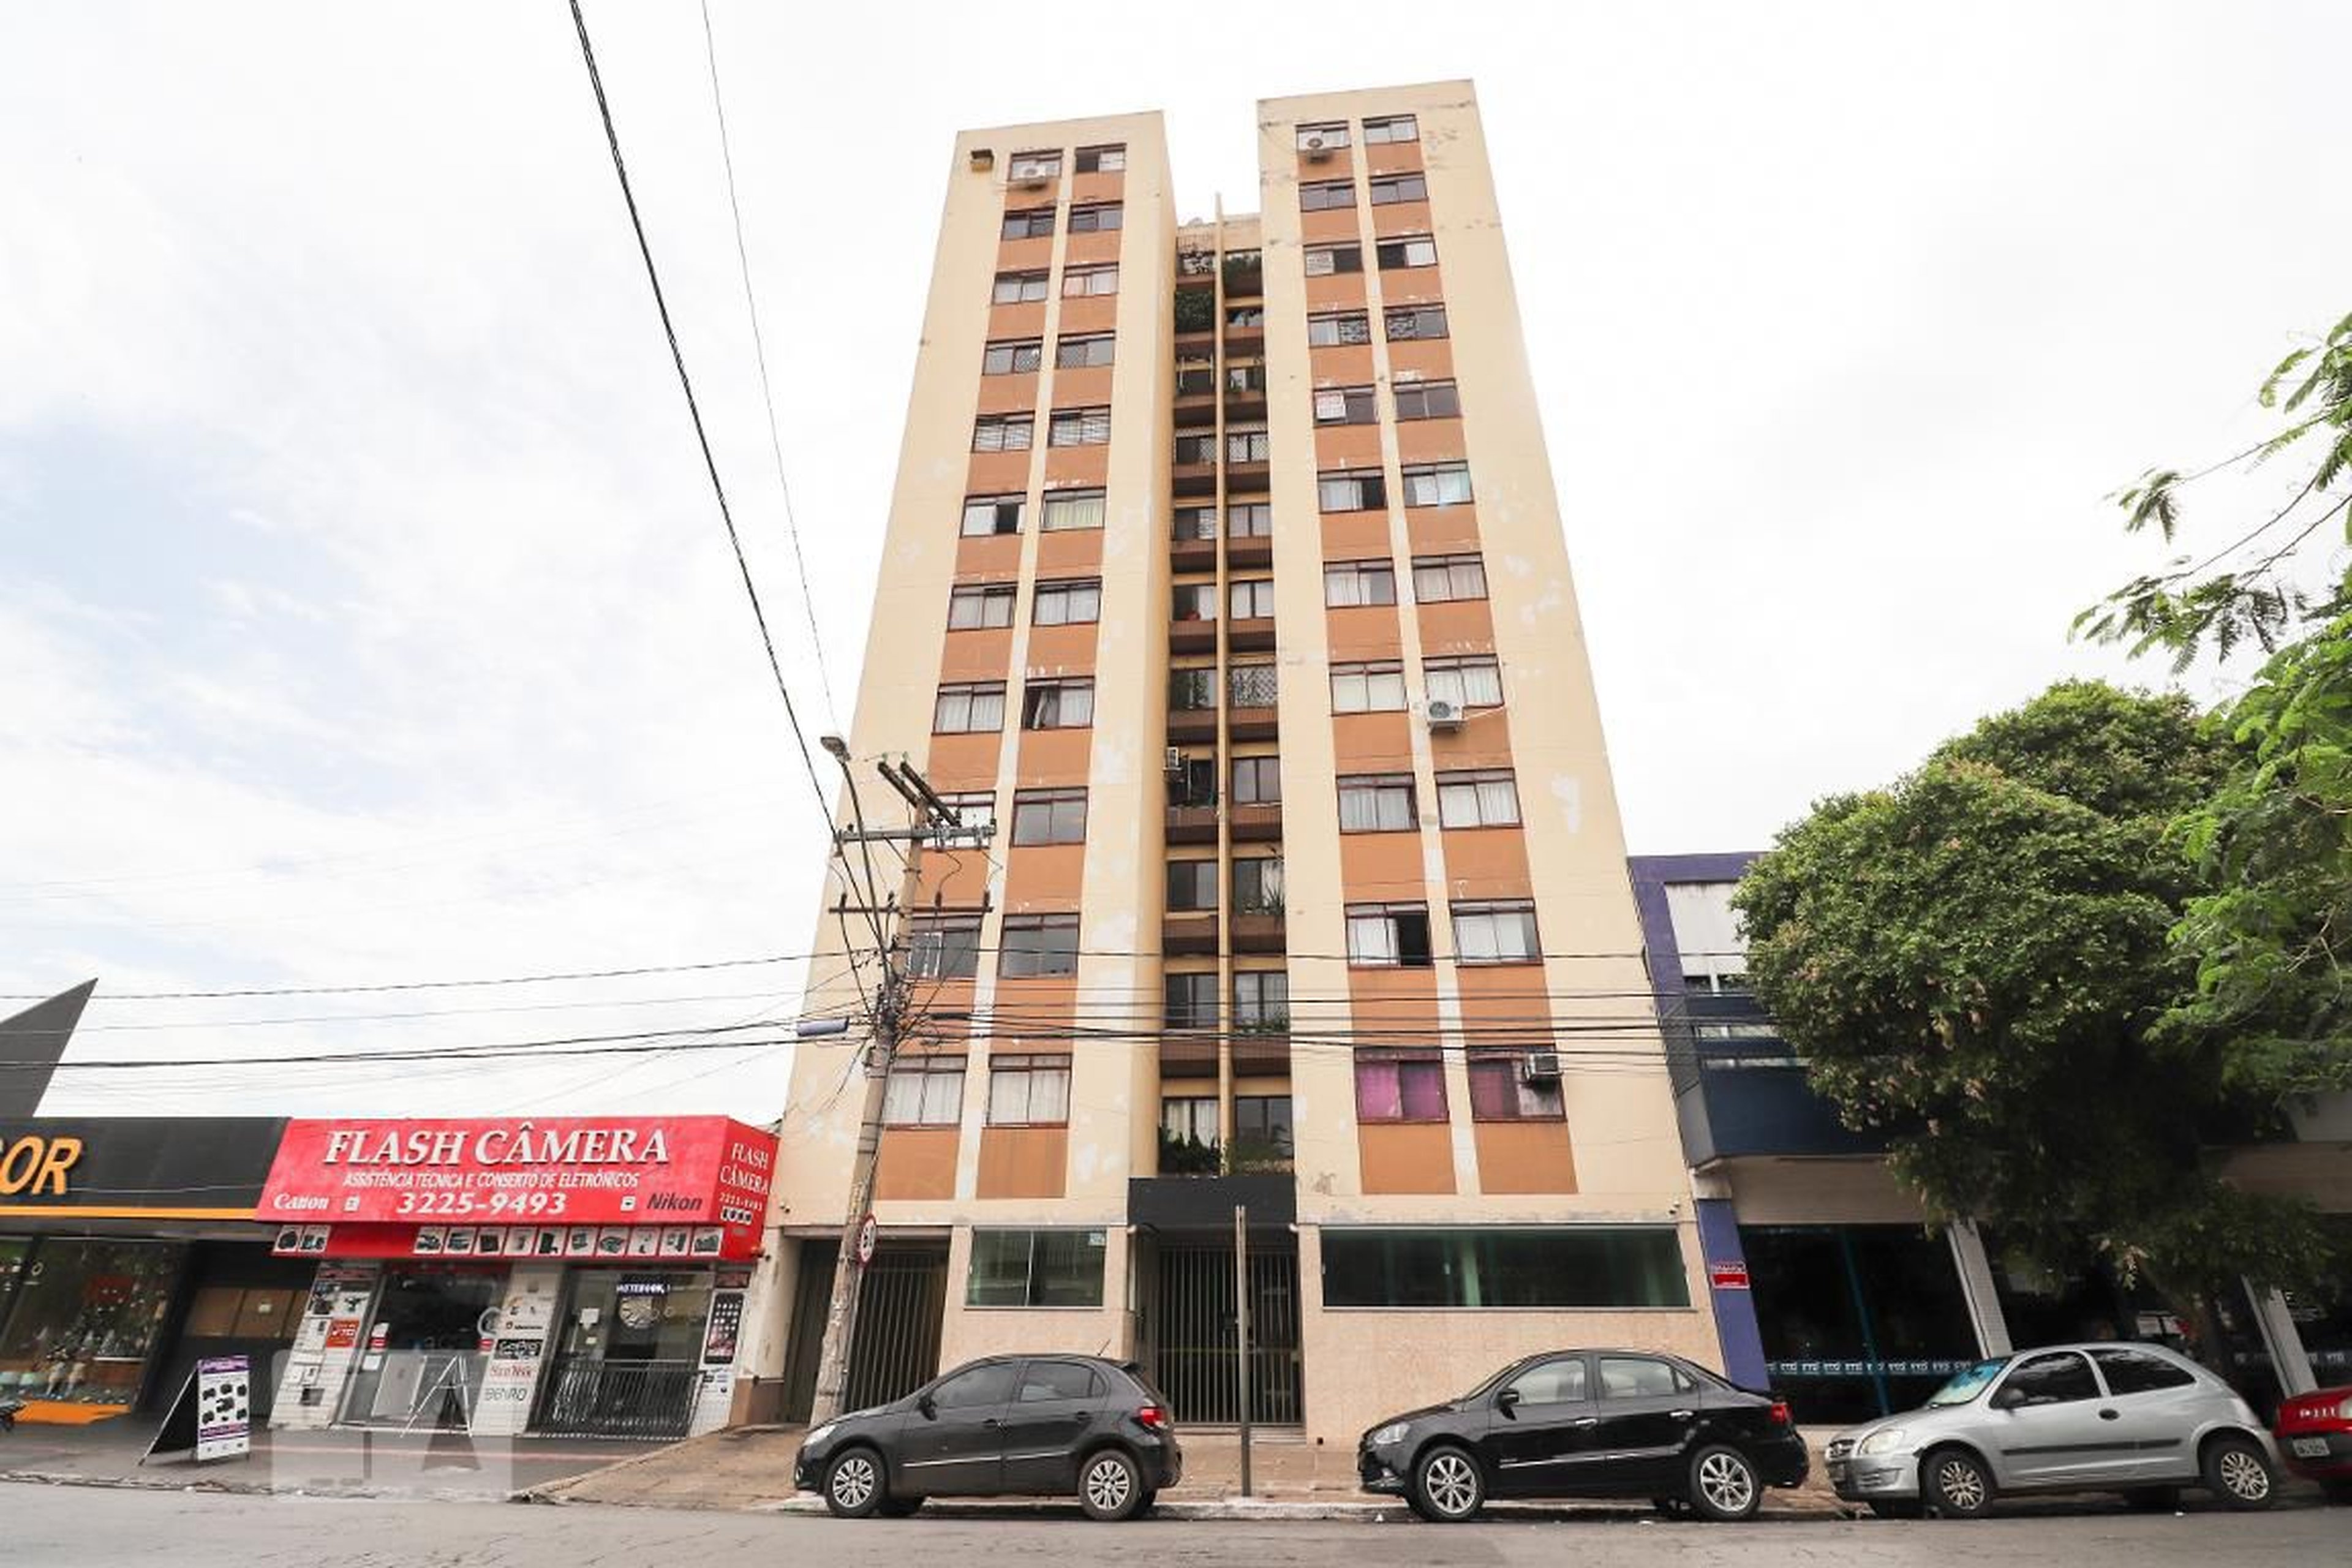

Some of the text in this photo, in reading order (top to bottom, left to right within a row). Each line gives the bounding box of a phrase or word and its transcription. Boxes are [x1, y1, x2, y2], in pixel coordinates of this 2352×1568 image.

[323, 1121, 671, 1166] FLASH CÂMERA
[731, 1142, 769, 1170] FLASH
[466, 1172, 475, 1188] E
[477, 1172, 538, 1188] CONSERTO
[540, 1172, 558, 1188] DE
[274, 1193, 330, 1210] Canon
[396, 1192, 567, 1215] 3225-9493
[647, 1192, 703, 1211] Nikon
